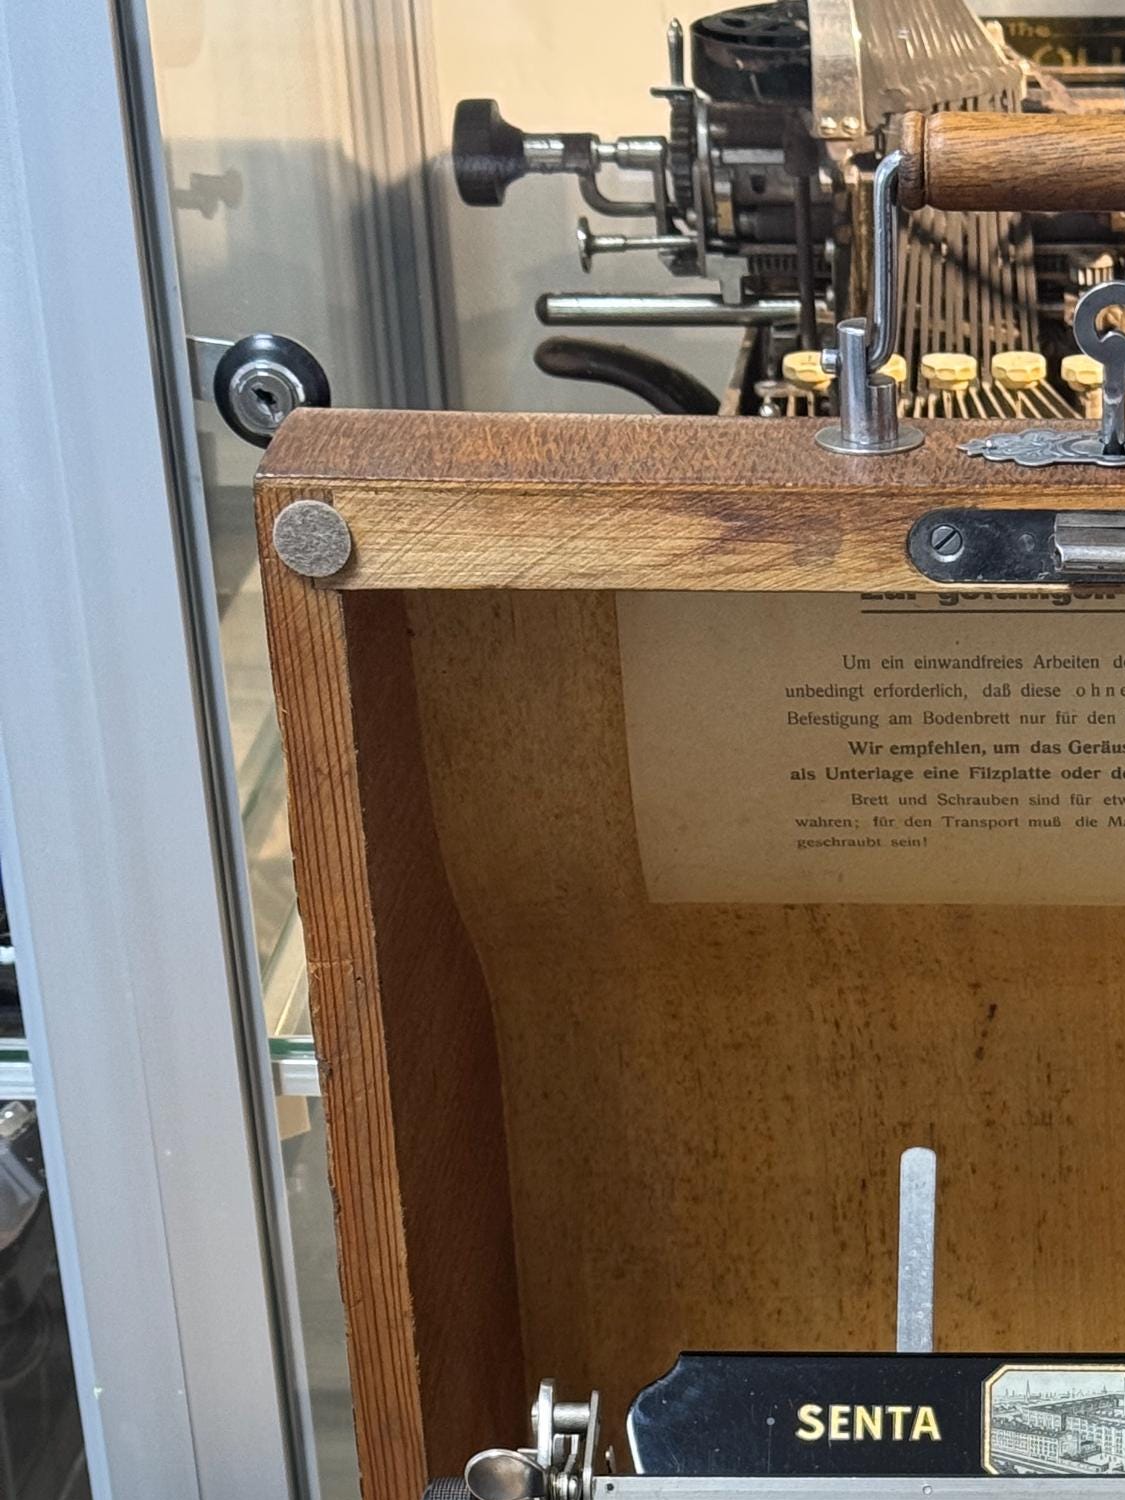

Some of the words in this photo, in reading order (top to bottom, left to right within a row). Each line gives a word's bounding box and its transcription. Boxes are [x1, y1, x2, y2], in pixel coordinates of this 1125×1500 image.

[842, 655, 871, 672] Um
[881, 656, 904, 671] ein
[913, 655, 1024, 671] einwandfreies
[1032, 655, 1100, 671] Arbeiten
[785, 684, 865, 703] unbedingt
[873, 683, 968, 702] erforderlich,
[982, 683, 1012, 699] daß
[1020, 683, 1061, 699] diese
[787, 711, 880, 731] Befestigung
[888, 715, 913, 727] am
[923, 711, 1011, 727] Bodenbrett
[1019, 715, 1047, 726] nur
[1055, 711, 1078, 726] für
[1086, 711, 1116, 726] den
[847, 741, 884, 757] Wir
[889, 740, 987, 760] empfehlen,
[992, 744, 1020, 756] um
[1029, 740, 1062, 756] das
[790, 768, 817, 782] als
[825, 767, 914, 784] Unterlage
[922, 766, 960, 781] eine
[968, 767, 1052, 785] Filzplatte
[1060, 766, 1102, 781] oder
[851, 794, 889, 807] Brett
[898, 794, 928, 807] und
[937, 793, 1019, 808] Schrauben
[1028, 794, 1060, 808] sind
[1069, 794, 1092, 808] für
[795, 817, 859, 831] wahren;
[872, 816, 894, 829] für
[904, 816, 932, 829] den
[941, 816, 1019, 832] Transport
[1028, 816, 1062, 829] muß
[1074, 816, 1098, 829] die
[797, 837, 881, 850] geschraubt
[890, 837, 927, 849] sein!
[795, 1403, 942, 1441] SENTA
